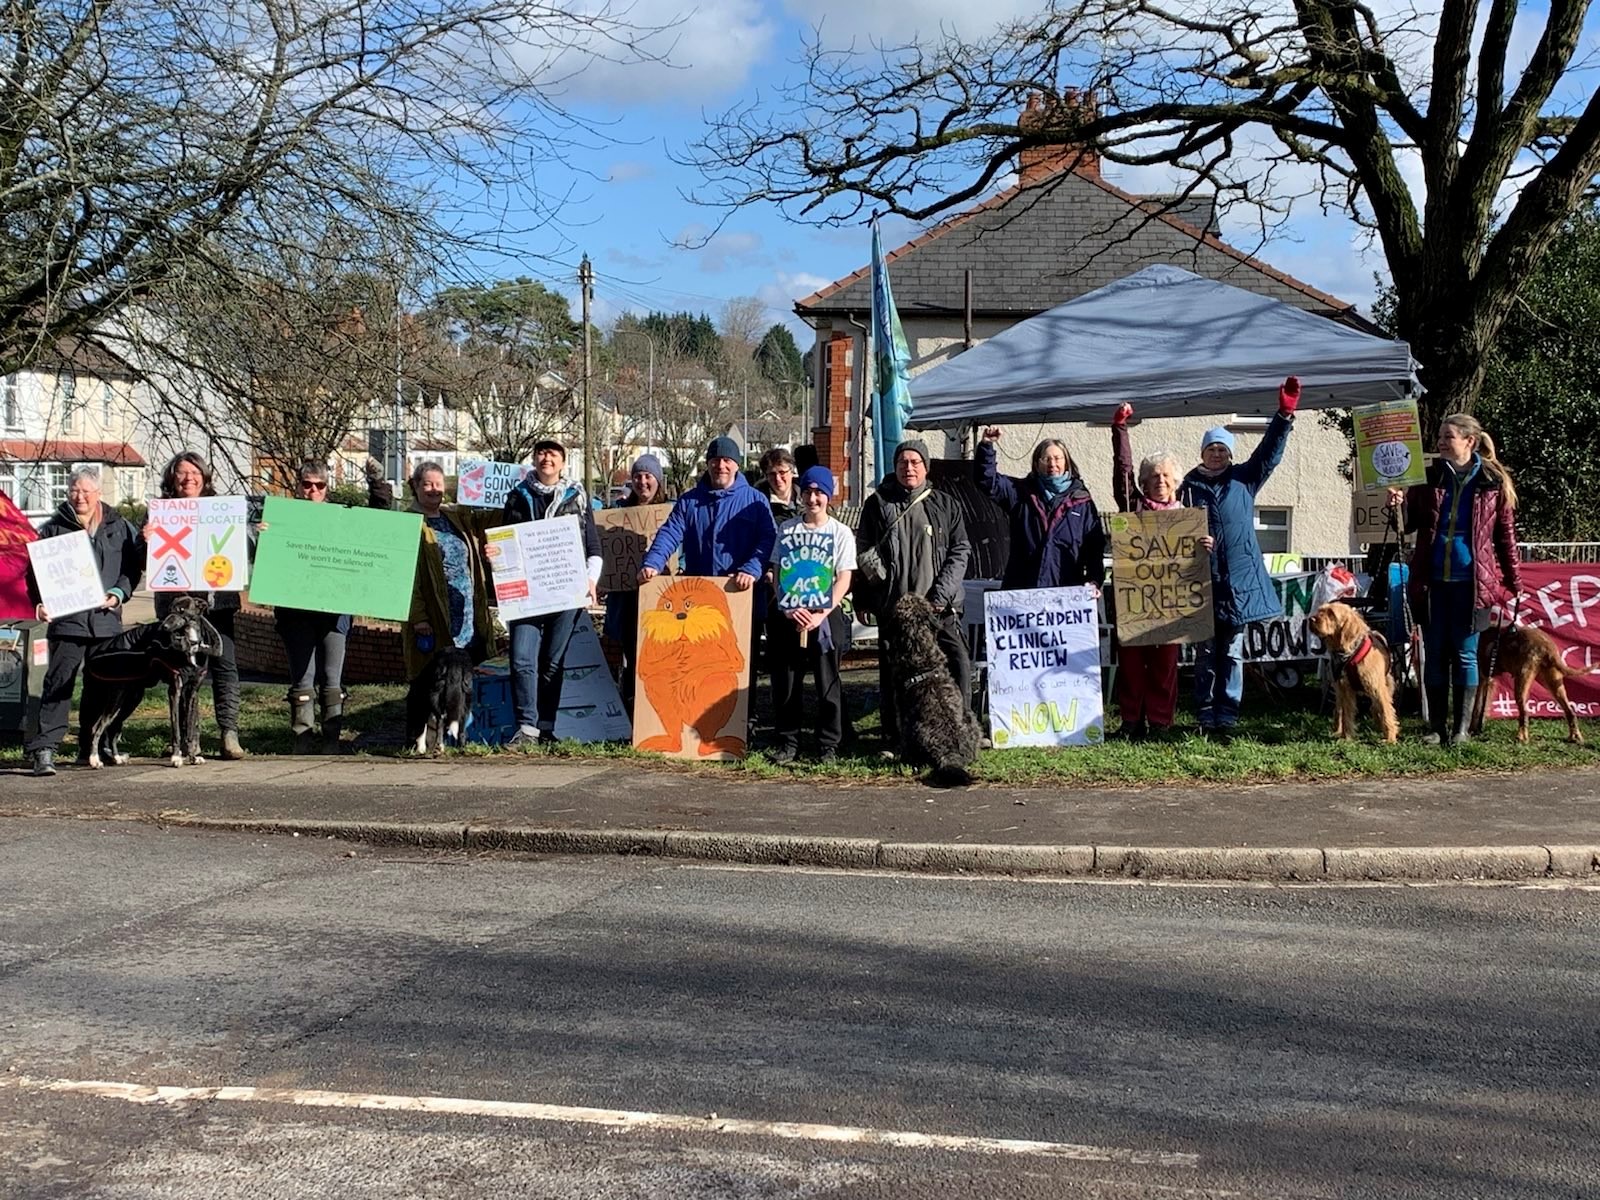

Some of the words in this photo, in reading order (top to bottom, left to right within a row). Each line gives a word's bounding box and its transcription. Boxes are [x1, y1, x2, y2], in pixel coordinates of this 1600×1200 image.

[1380, 443, 1399, 457] SAVE
[493, 464, 510, 476] NO
[151, 500, 198, 510] STAND
[212, 502, 234, 511] CO-
[152, 515, 198, 525] ALONE
[199, 515, 245, 524] LOCATE
[606, 509, 662, 533] SAVE
[550, 526, 570, 534] DELIVER
[32, 533, 79, 559] CLEAN
[286, 540, 303, 549] Save
[304, 543, 317, 551] the
[319, 545, 351, 555] Northern
[526, 541, 574, 552] TRANSFORMATION
[601, 533, 656, 556] FORE
[781, 533, 832, 551] THINK
[1129, 535, 1196, 561] SAVE
[298, 552, 309, 560] We
[311, 555, 331, 563] won't
[332, 556, 342, 564] be
[781, 545, 833, 570] GLOBAL
[48, 558, 78, 578] AIR
[1136, 562, 1185, 580] OUR
[792, 576, 819, 592] ACT
[45, 585, 98, 611] THRIVE
[780, 590, 830, 608] LOCAL
[1119, 581, 1204, 618] TREES
[1492, 575, 1600, 629] EEP
[990, 608, 1092, 632] INDEPENDENT
[996, 630, 1067, 650] CLINICAL
[1010, 649, 1067, 670] REVIEW
[990, 679, 1013, 695] When
[1019, 680, 1029, 691] do
[1011, 697, 1078, 736] NOW
